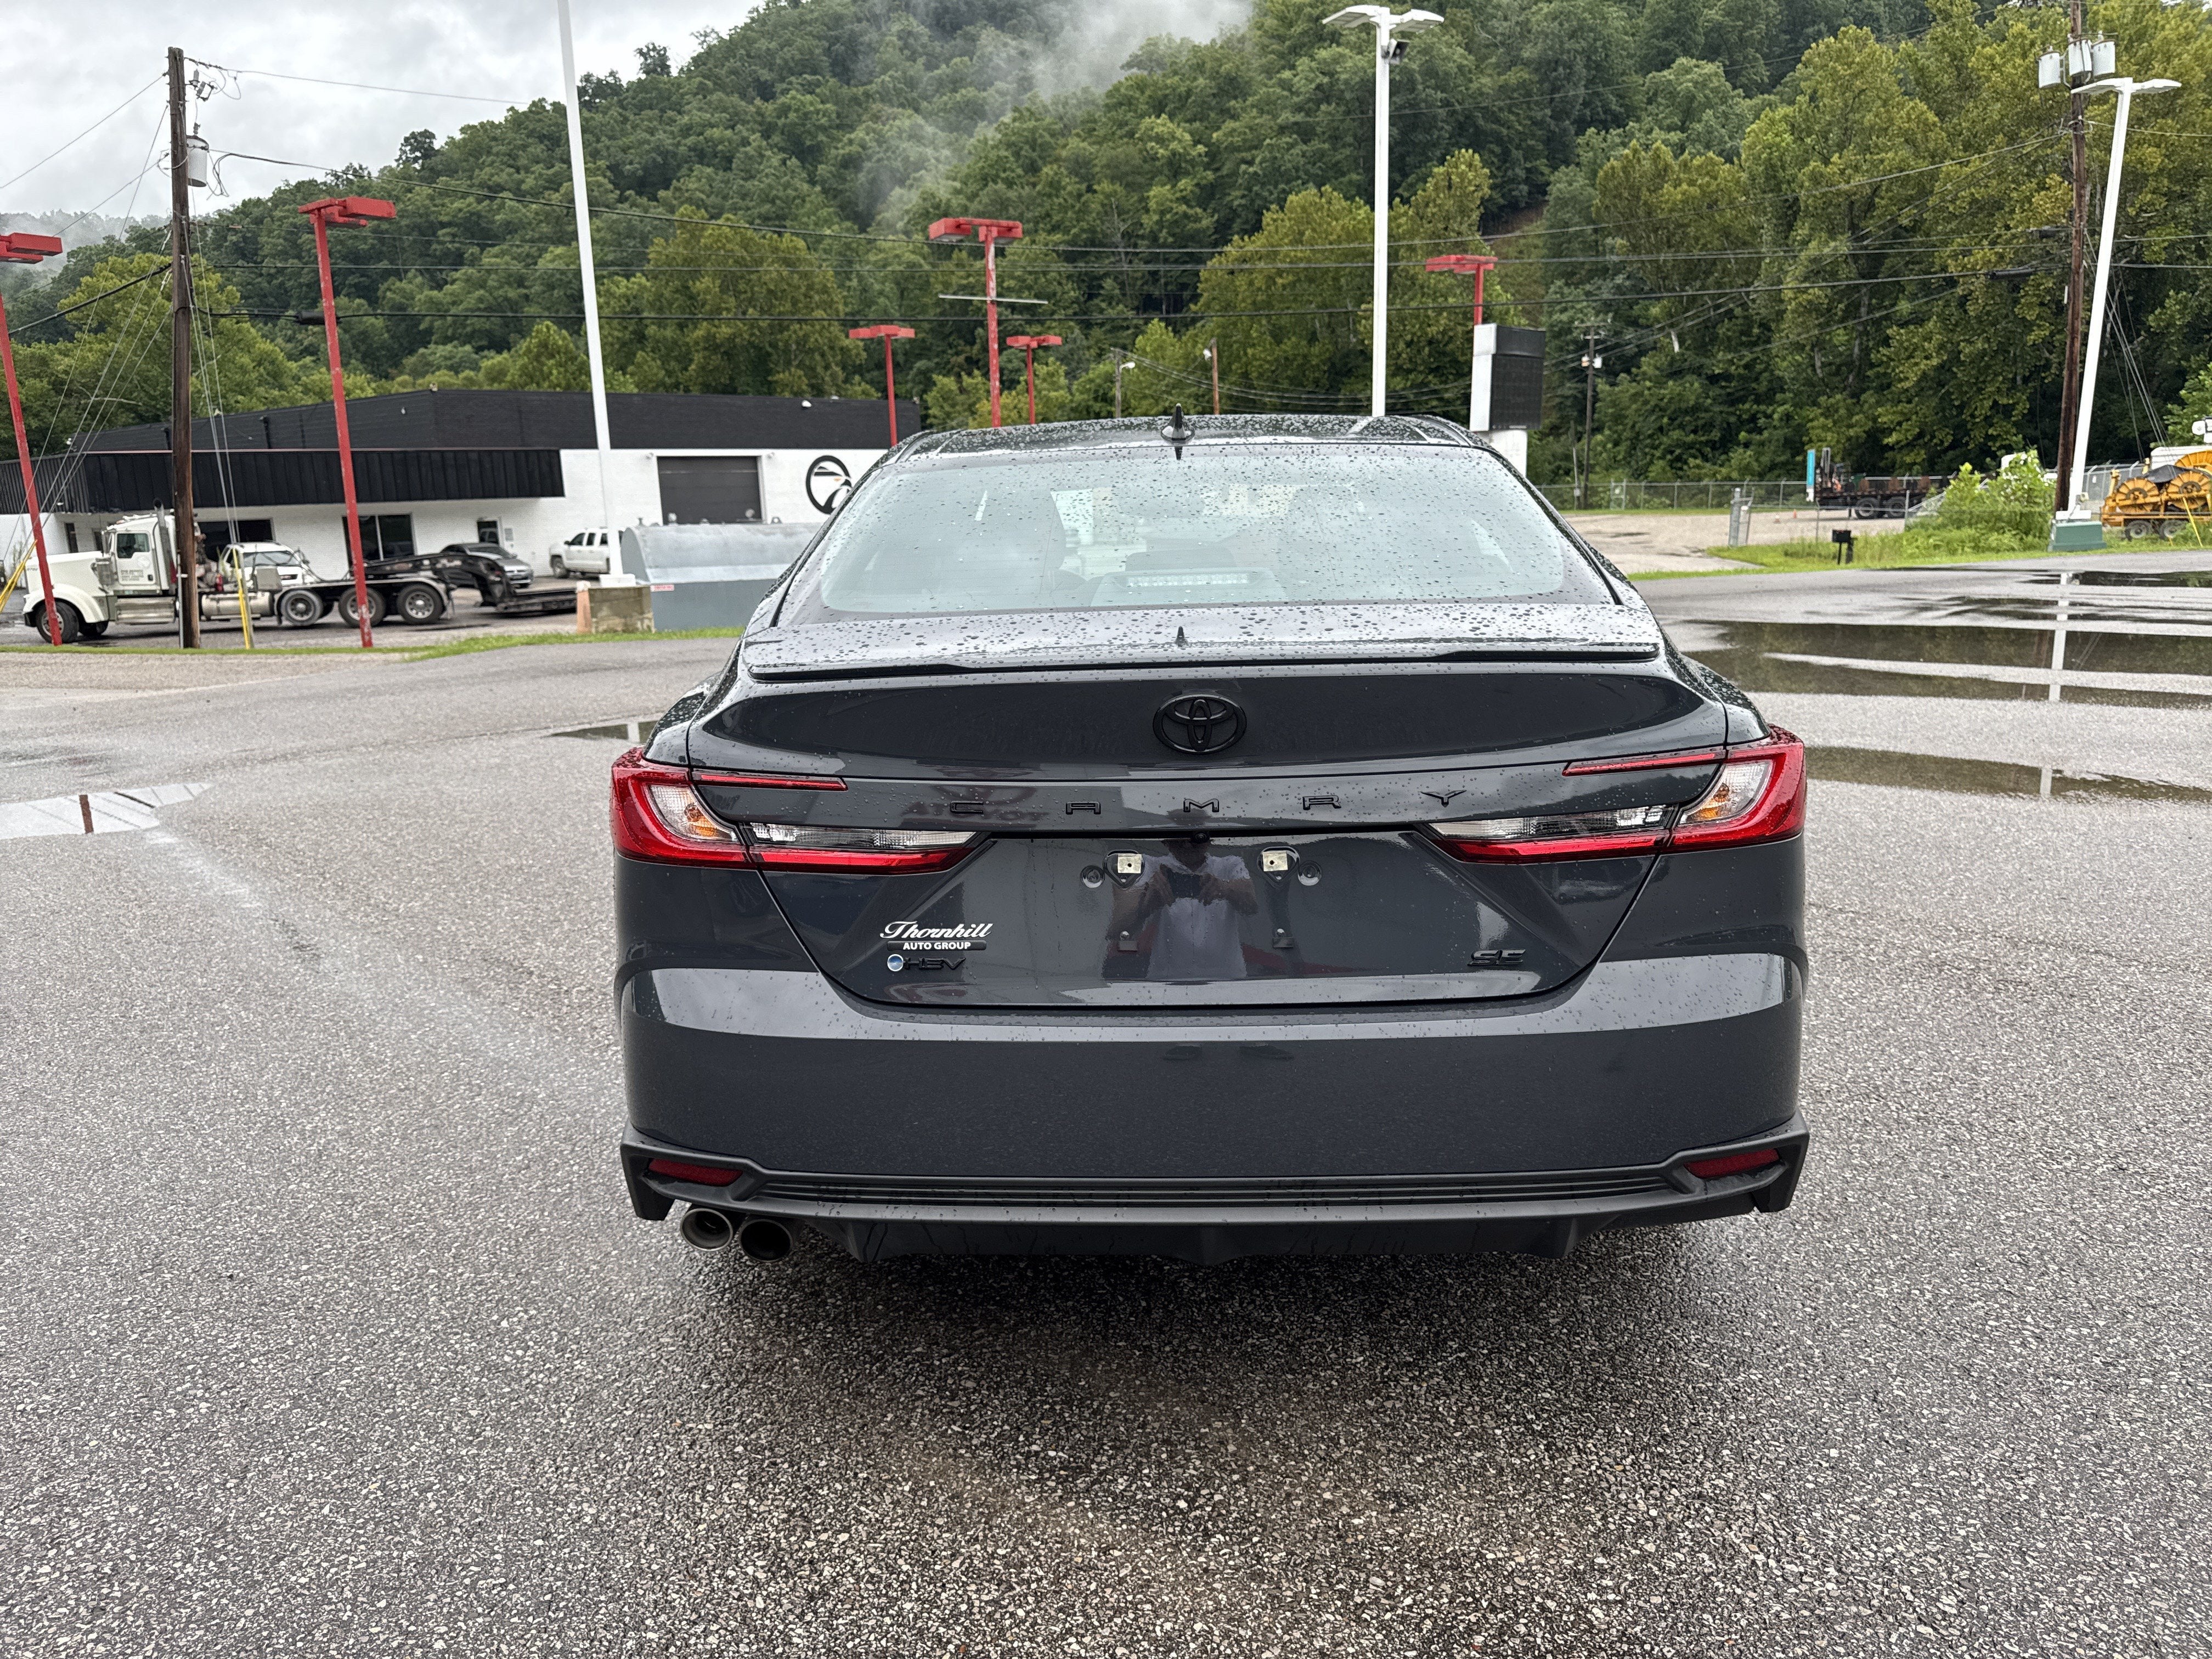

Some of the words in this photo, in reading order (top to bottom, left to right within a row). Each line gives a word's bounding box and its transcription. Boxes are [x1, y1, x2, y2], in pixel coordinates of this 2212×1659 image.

[949, 789, 1467, 815] CAMRY
[879, 921, 994, 939] Thornhill
[904, 957, 966, 970] HEV
[1467, 949, 1526, 967] SE
